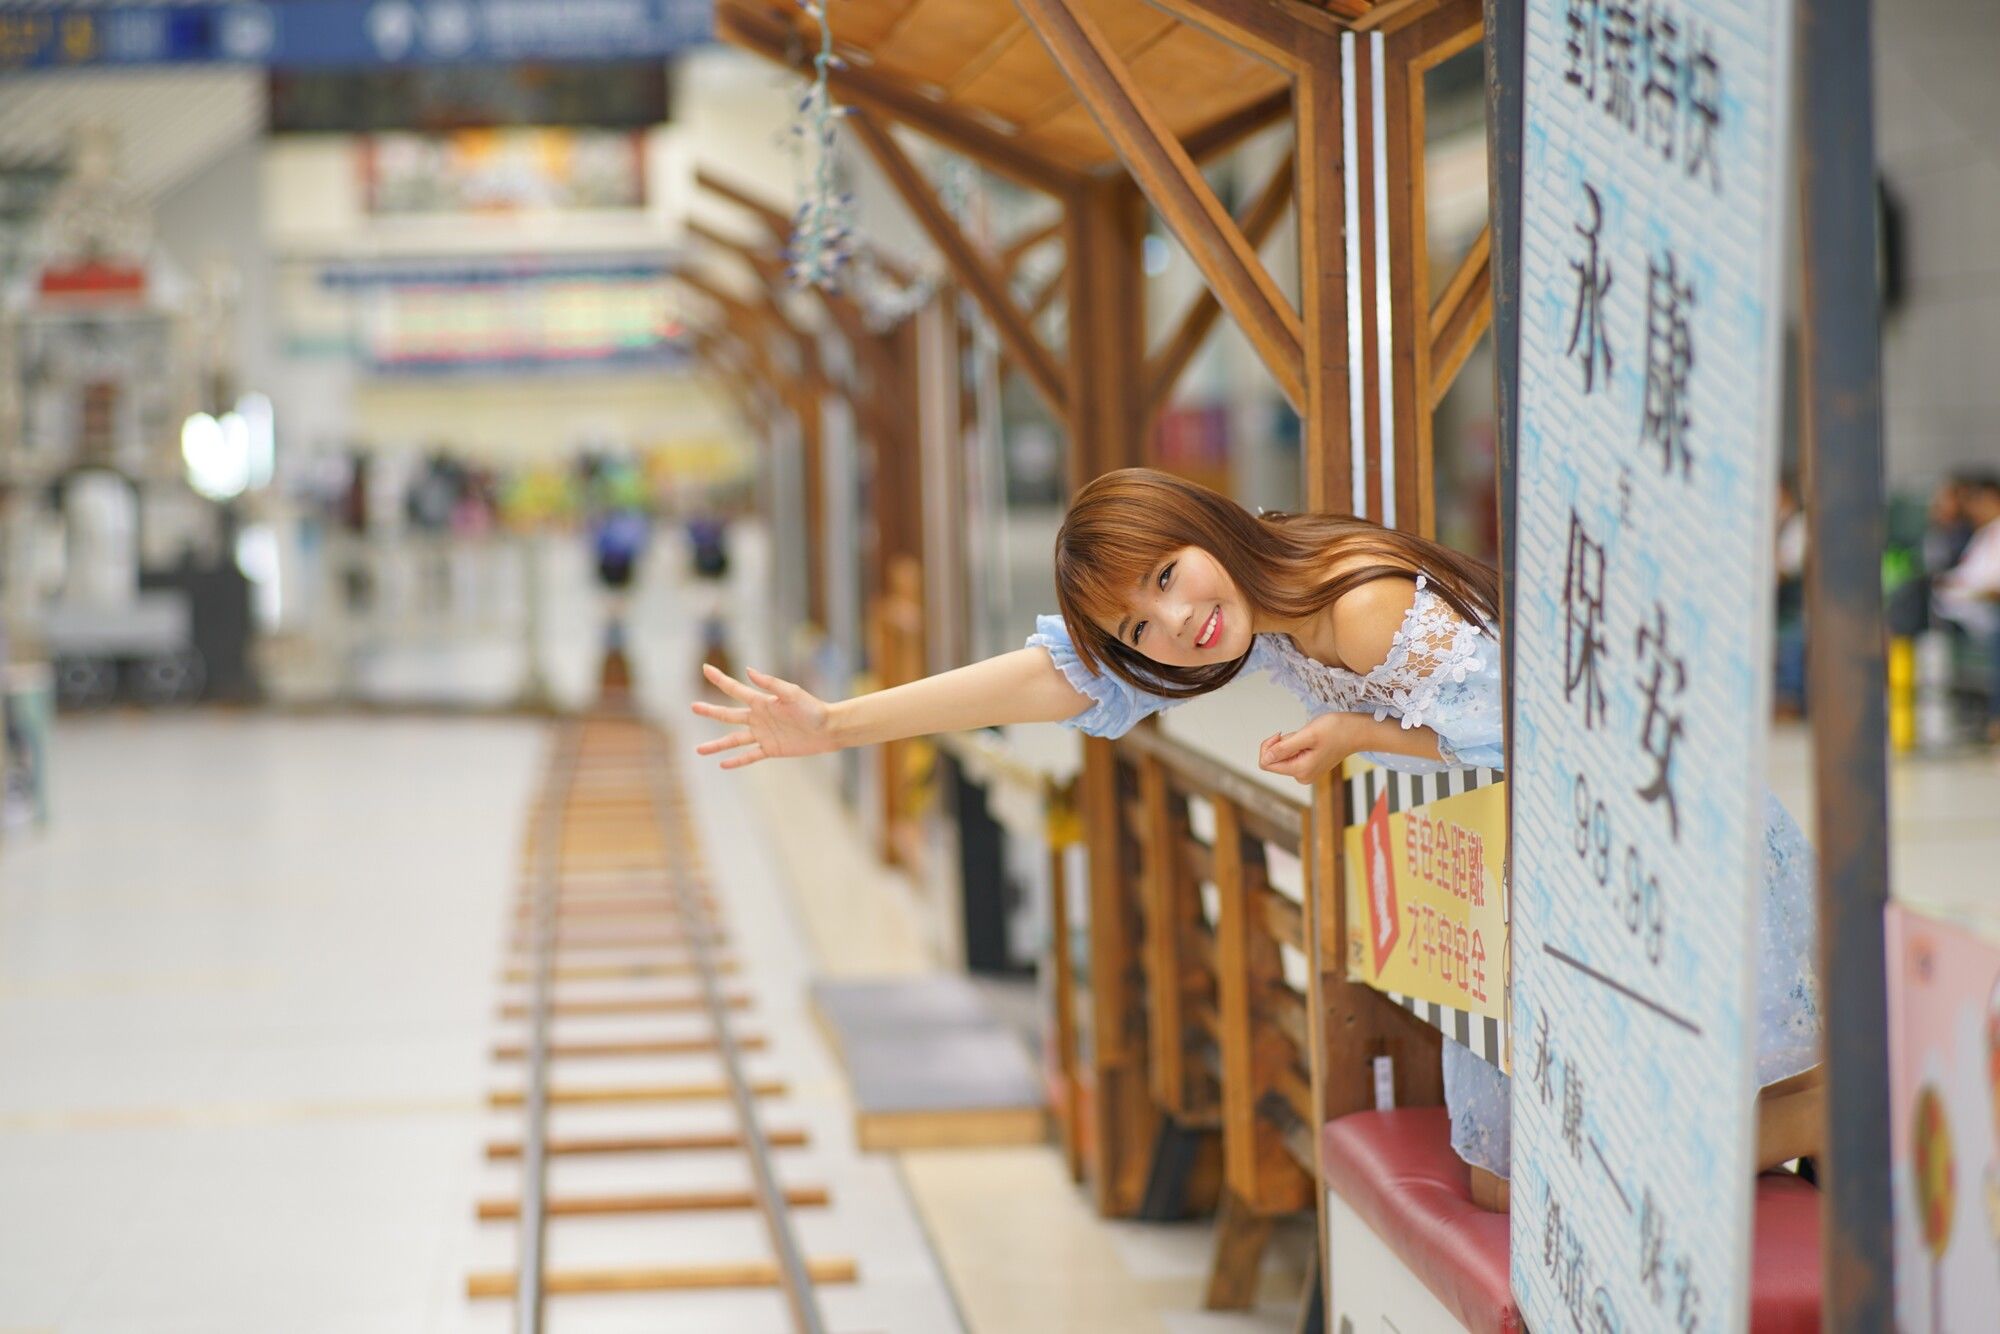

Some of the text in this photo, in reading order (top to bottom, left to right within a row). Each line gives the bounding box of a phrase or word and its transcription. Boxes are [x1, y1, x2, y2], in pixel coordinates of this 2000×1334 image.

[1567, 181, 1697, 483] 永康
[1563, 507, 1688, 844] 保安
[1404, 807, 1485, 906] 有安全距離
[1407, 900, 1487, 1003] 才平安安全
